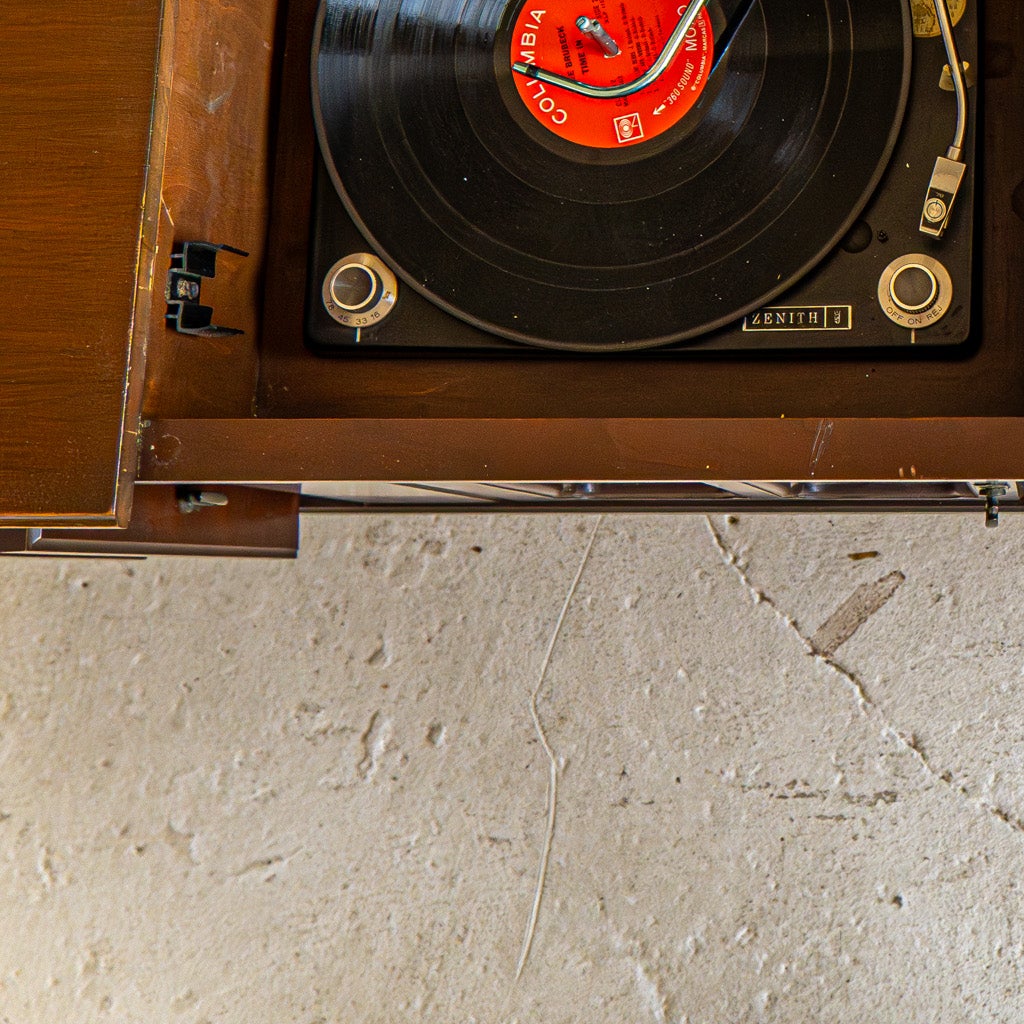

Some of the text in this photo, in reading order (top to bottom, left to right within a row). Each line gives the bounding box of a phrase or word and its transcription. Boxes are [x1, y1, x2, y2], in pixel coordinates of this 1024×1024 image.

[557, 26, 573, 68] BRUBECK
[576, 40, 589, 74] TIME IN
[338, 314, 349, 322] 45
[355, 317, 368, 325] 33
[751, 311, 818, 325] ZENITH
[886, 305, 943, 325] OFF ON REJ
